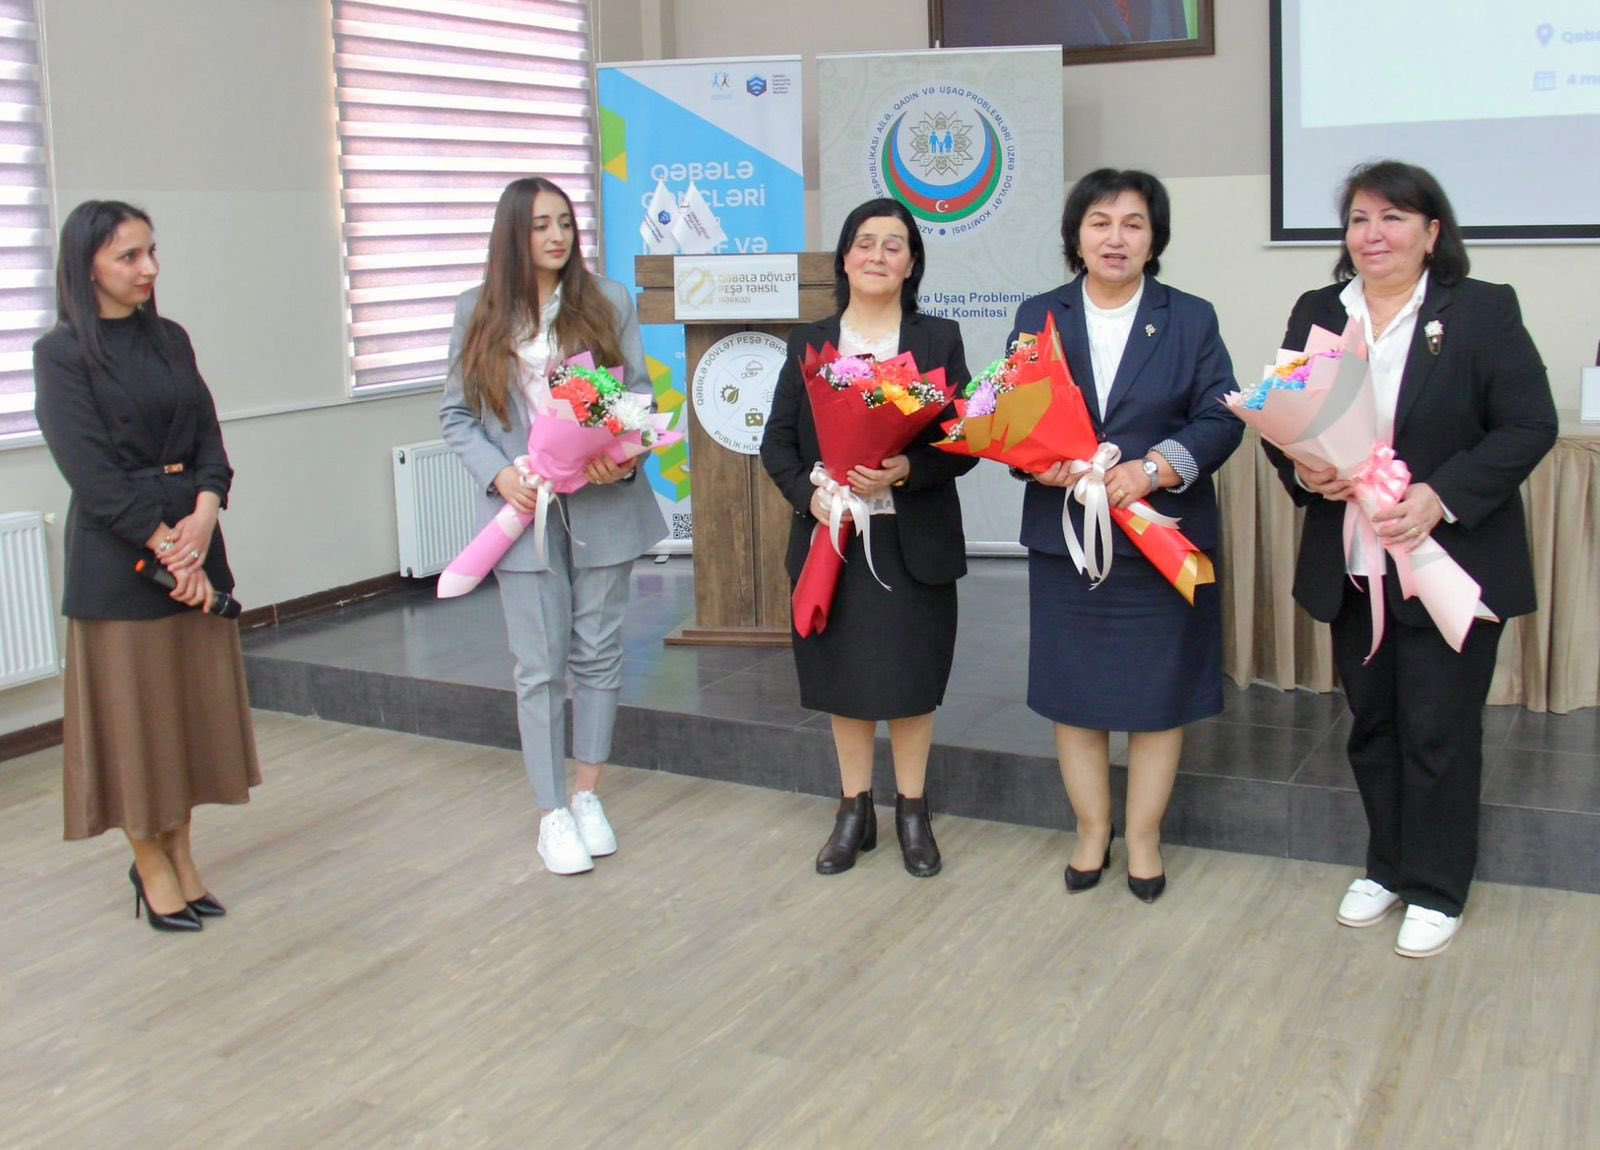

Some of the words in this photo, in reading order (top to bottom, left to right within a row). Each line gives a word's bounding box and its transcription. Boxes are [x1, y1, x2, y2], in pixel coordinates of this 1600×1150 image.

[922, 87, 936, 96] VƏ
[940, 86, 965, 97] UŞAQ
[893, 91, 919, 111] QADIN
[965, 91, 1013, 142] PROBLEMLƏRİ
[1006, 145, 1016, 171] ÜZRƏ
[651, 161, 754, 182] QƏBƏLƏ
[951, 209, 992, 236] KOMİTƏSİ
[760, 271, 798, 282] DÖVLƏT
[745, 283, 779, 293] TƏHSİL
[934, 291, 966, 306] Uşaq
[952, 306, 1008, 318] Komitəsi
[736, 336, 762, 345] PEŞƏ
[763, 338, 788, 356] TƏHS
